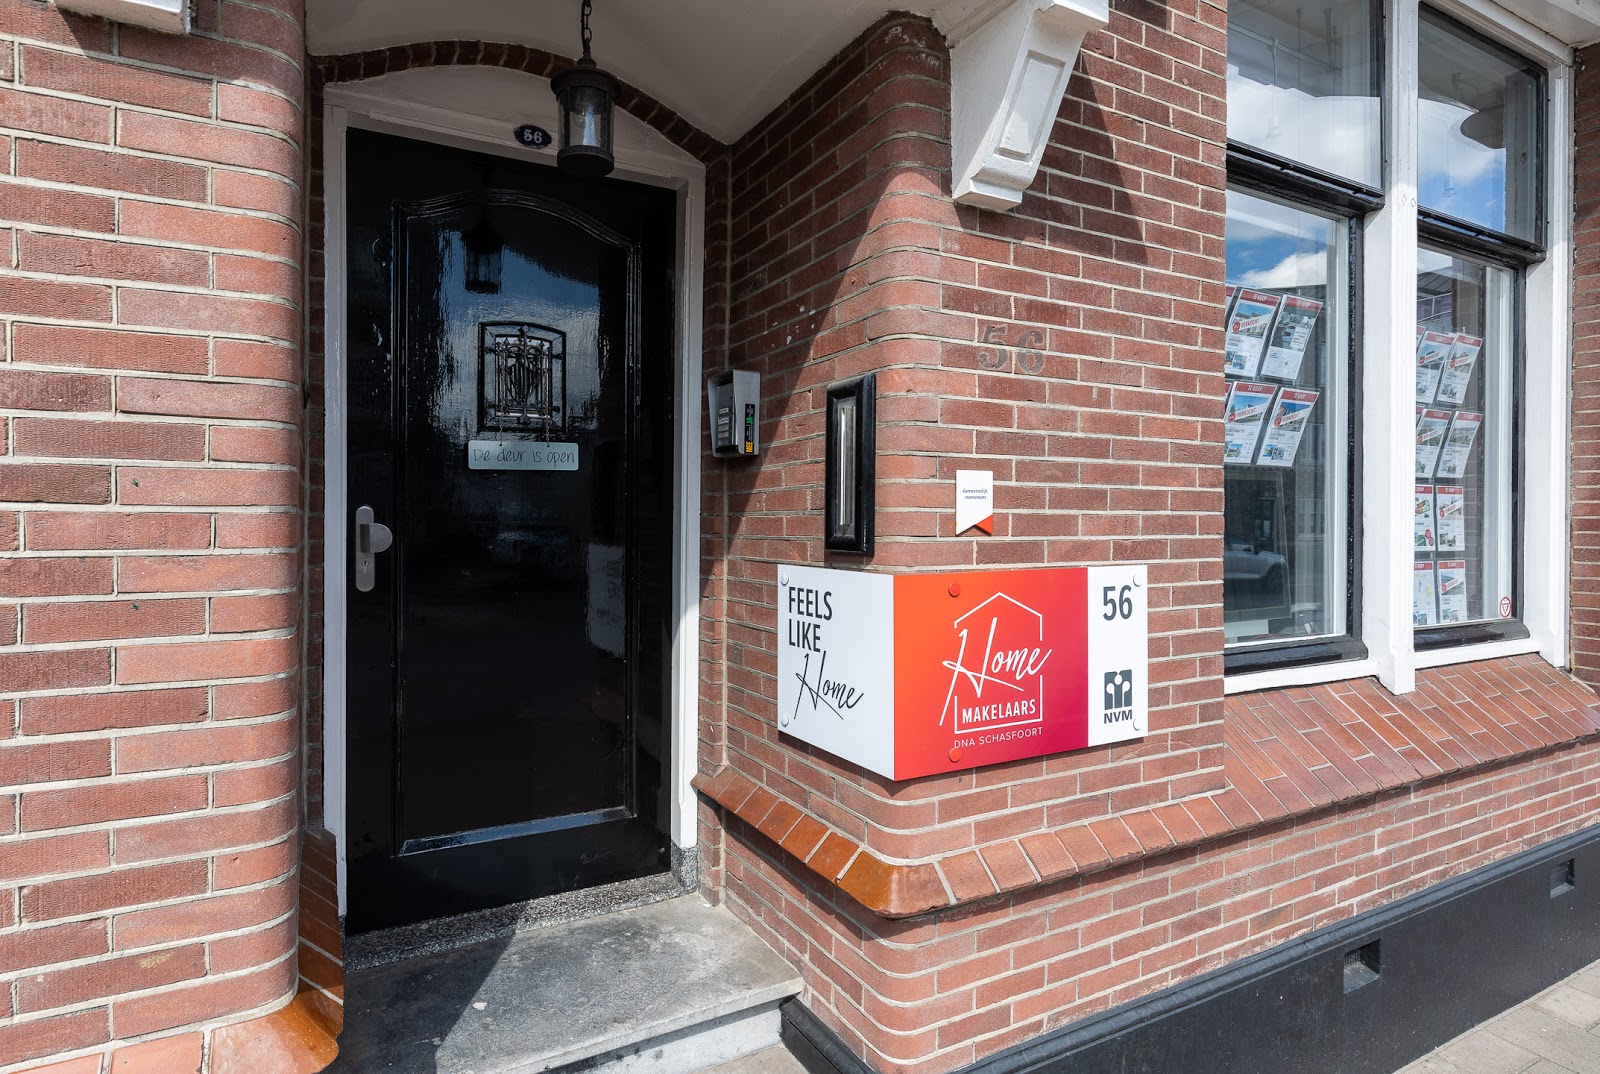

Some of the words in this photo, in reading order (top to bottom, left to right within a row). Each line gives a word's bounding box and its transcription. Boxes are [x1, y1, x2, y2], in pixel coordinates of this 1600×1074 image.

[523, 128, 543, 144] 56
[978, 323, 1046, 375] 56
[473, 448, 491, 462] De
[496, 449, 527, 462] deur
[532, 449, 542, 463] is
[546, 451, 575, 468] open
[745, 441, 754, 453] NEE
[788, 586, 833, 621] FEELS
[1102, 584, 1133, 621] 56
[788, 618, 821, 653] LIKE
[793, 650, 865, 720] Home
[939, 617, 1052, 726] Home
[962, 699, 1036, 724] MAKELAARS
[1103, 709, 1133, 724] NVM
[954, 739, 976, 749] DNA
[979, 726, 1043, 745] SCHASFOORT
